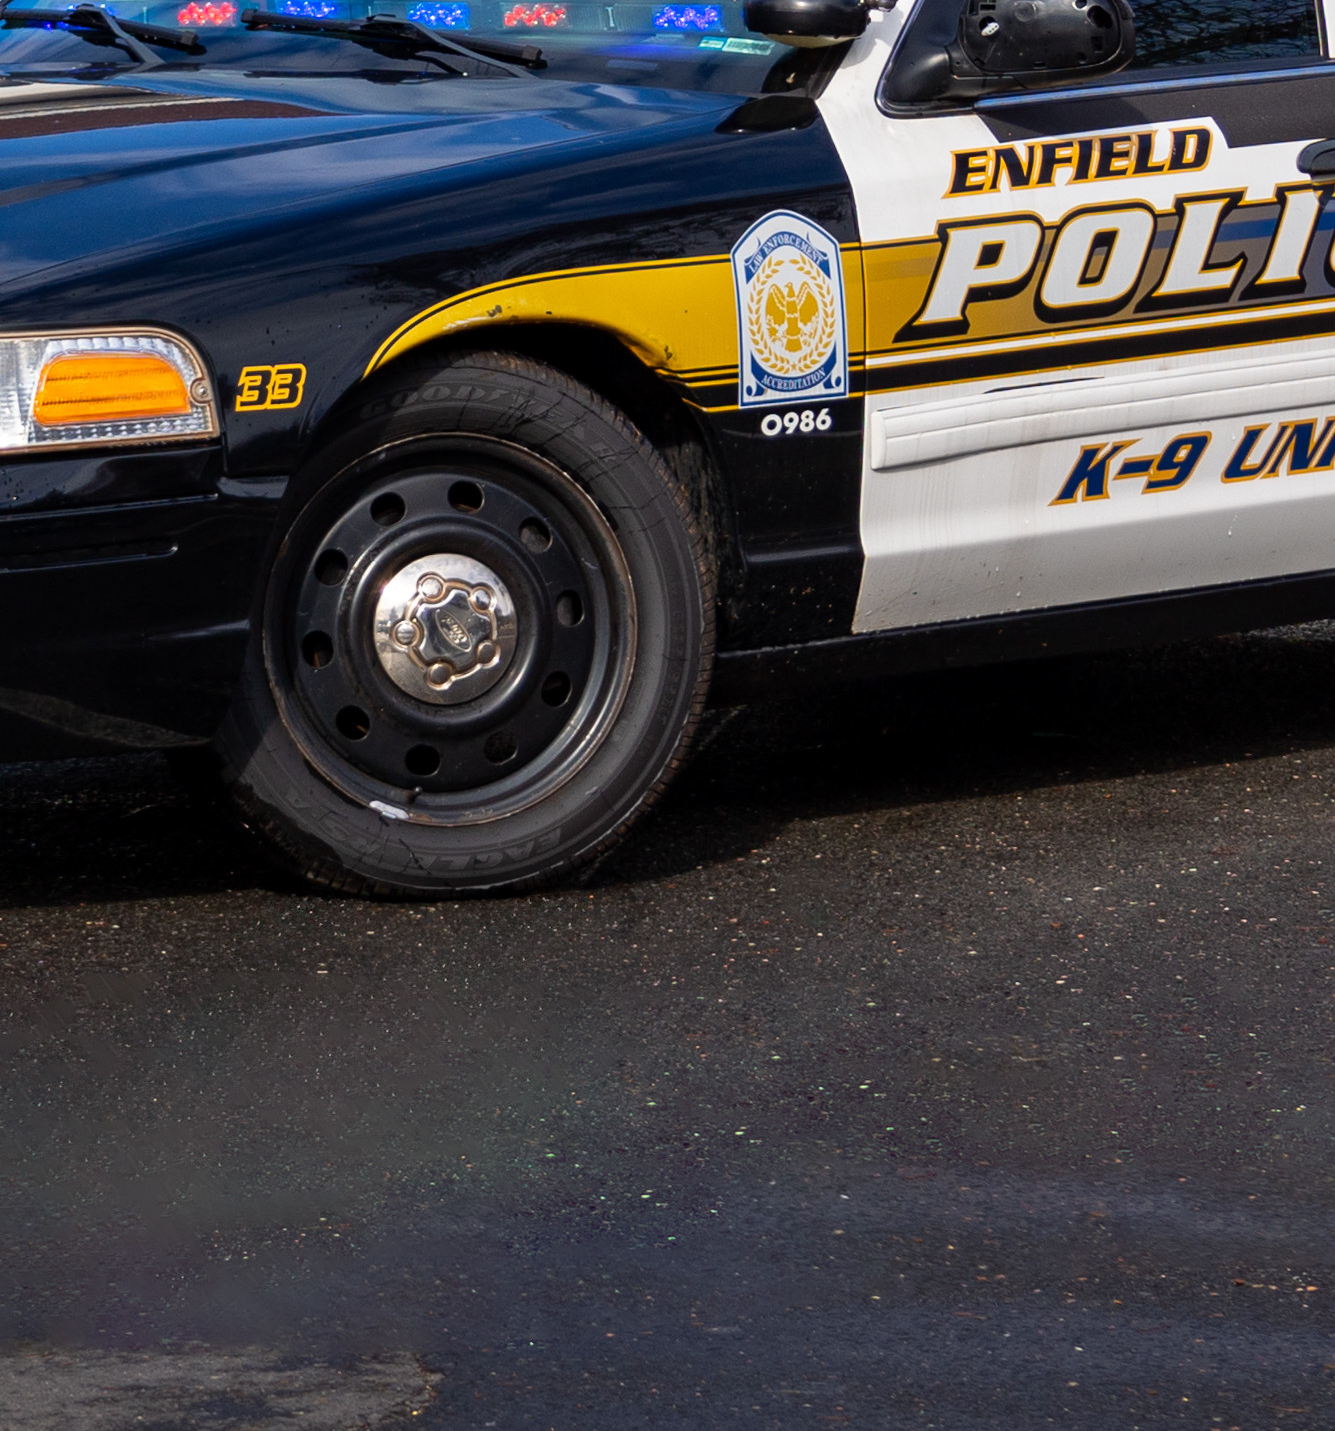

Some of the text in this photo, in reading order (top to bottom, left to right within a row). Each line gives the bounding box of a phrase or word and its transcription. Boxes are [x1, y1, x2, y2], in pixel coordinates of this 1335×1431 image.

[941, 125, 1214, 199] ENFIELD
[749, 233, 822, 273] LAW ENFORCEMENT
[235, 363, 307, 412] 33
[761, 367, 826, 390] ACCREDITATION
[761, 408, 832, 436] 0986
[1047, 430, 1213, 506] K-9
